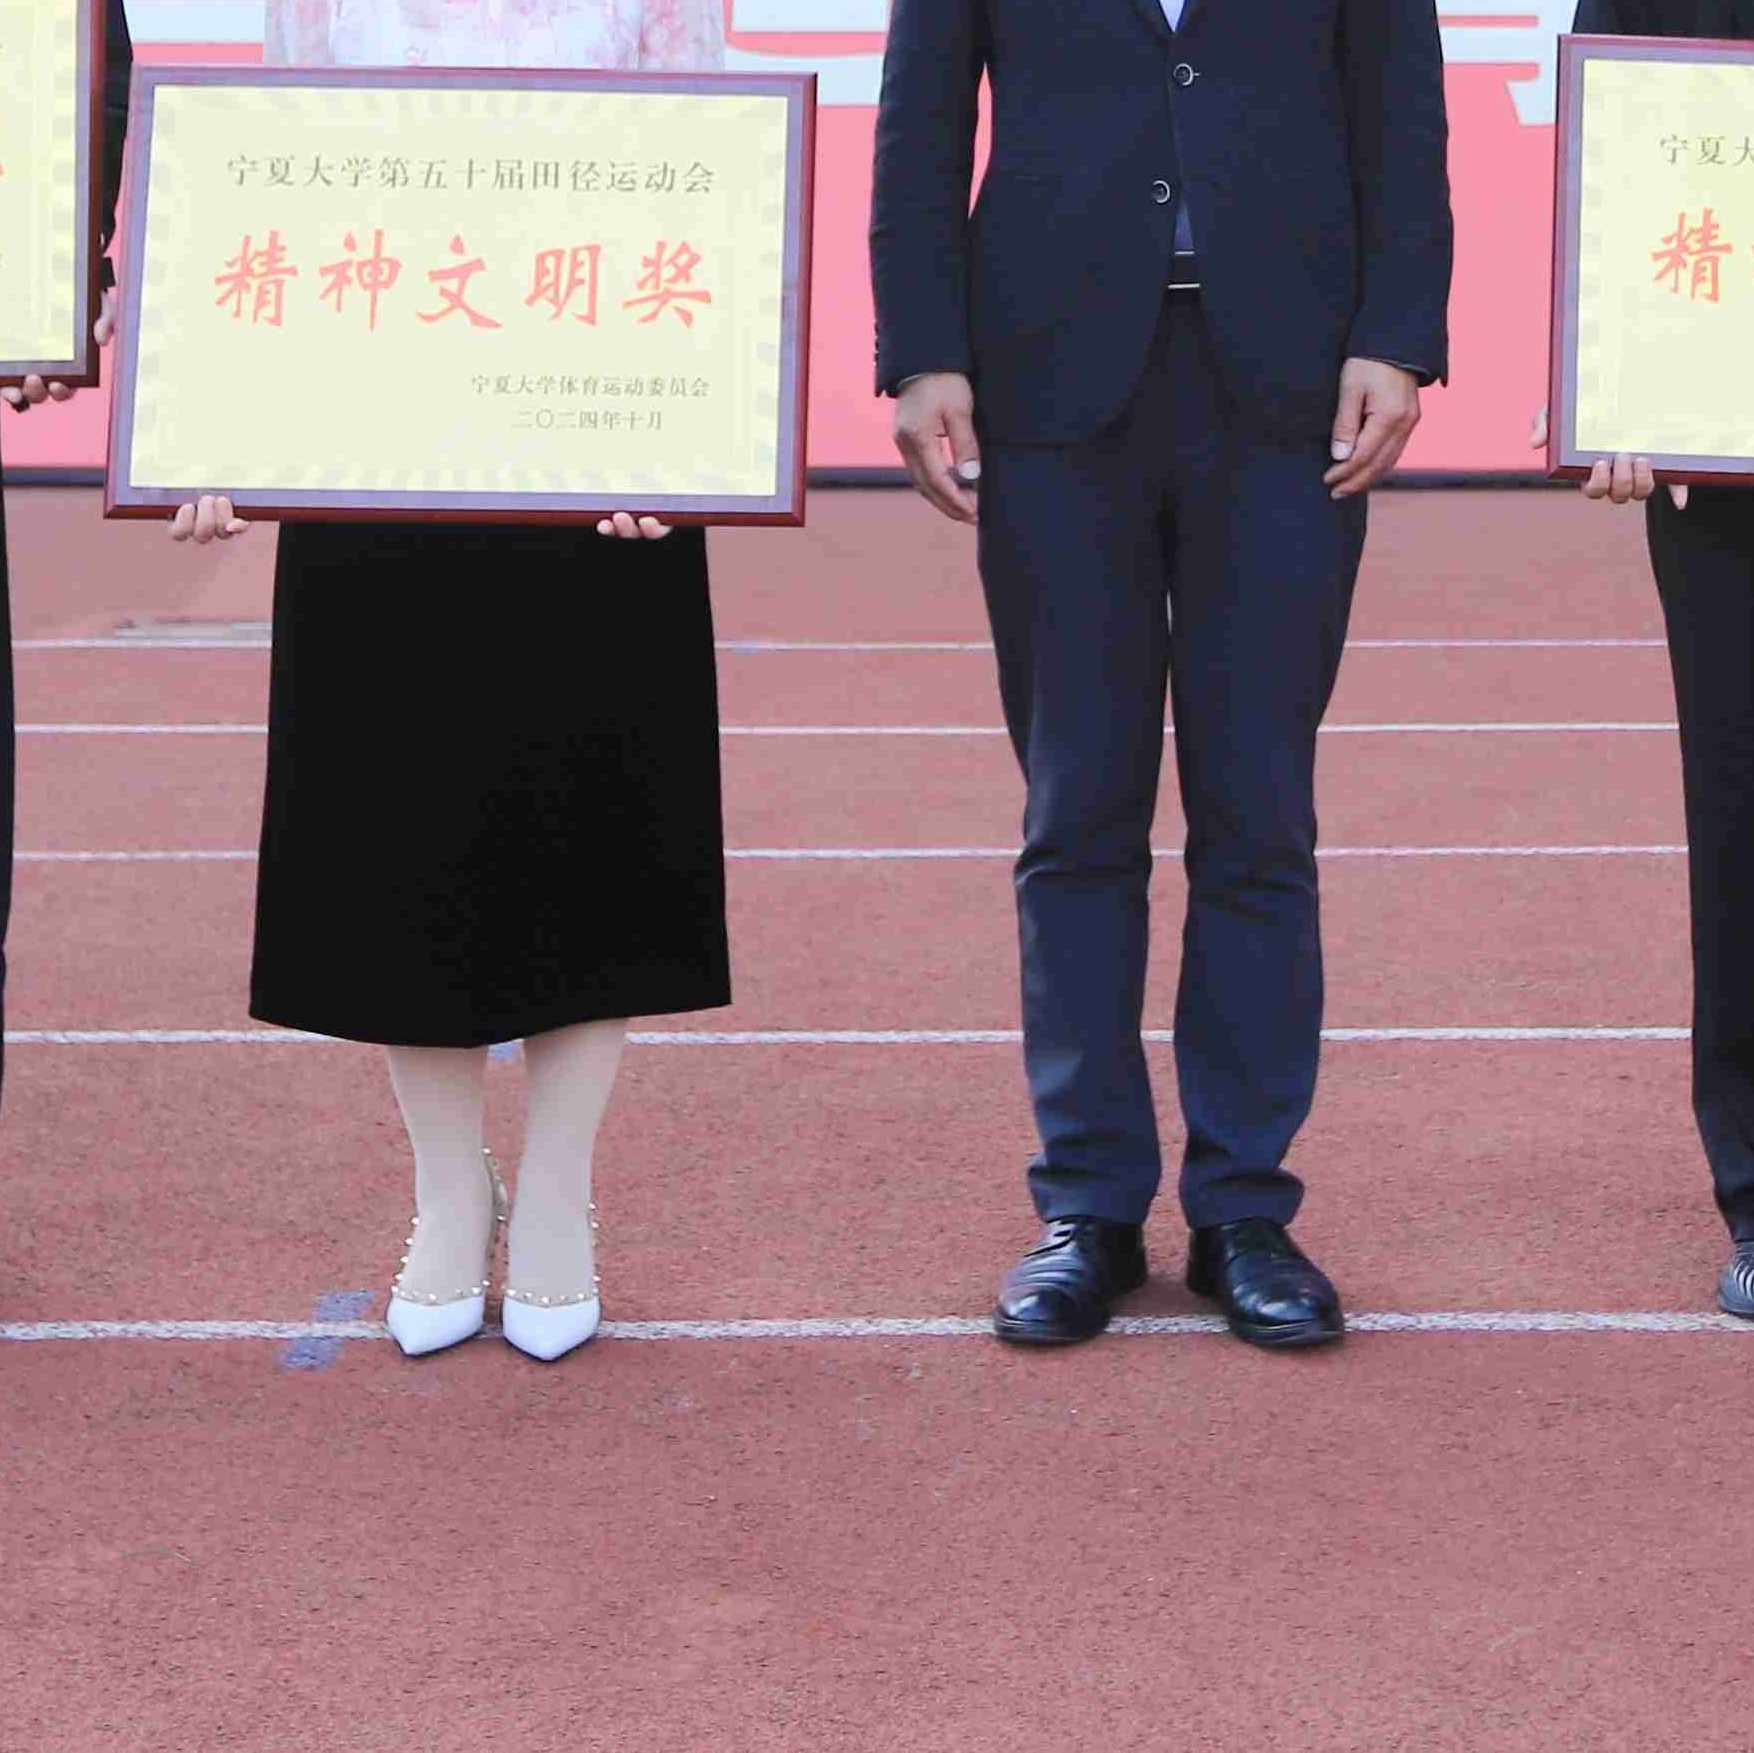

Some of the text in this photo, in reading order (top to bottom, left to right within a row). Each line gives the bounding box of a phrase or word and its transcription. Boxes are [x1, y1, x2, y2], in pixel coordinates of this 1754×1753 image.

[226, 154, 716, 194] 宁夏大学第五十届田径运动会
[214, 229, 712, 332] 精神文明奖
